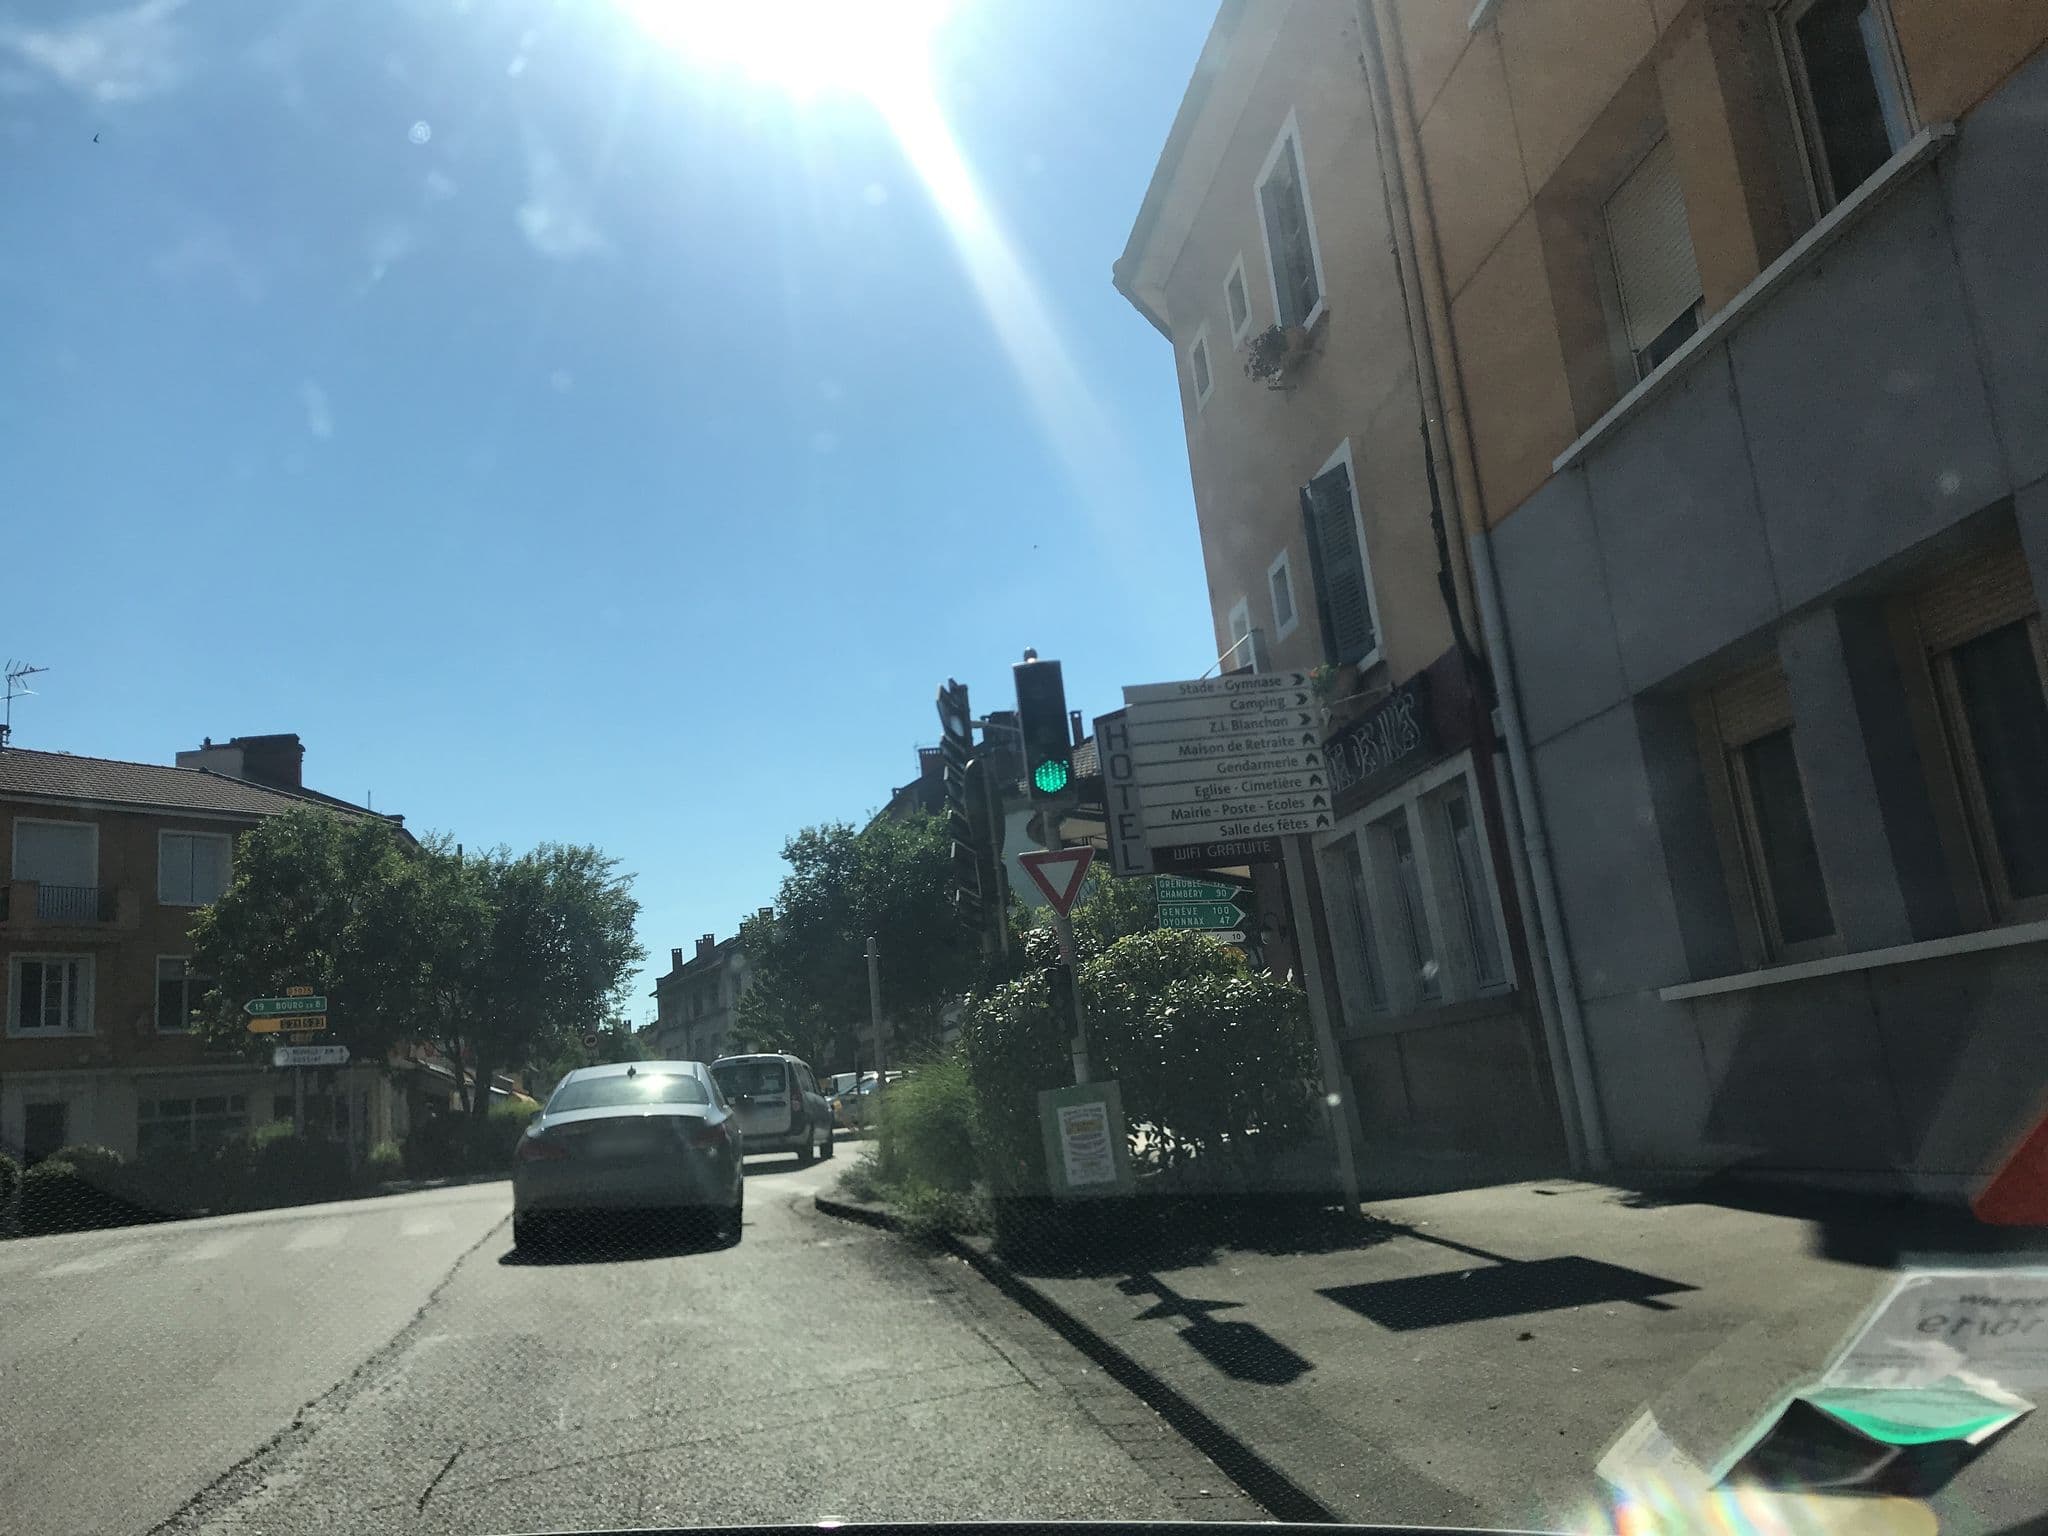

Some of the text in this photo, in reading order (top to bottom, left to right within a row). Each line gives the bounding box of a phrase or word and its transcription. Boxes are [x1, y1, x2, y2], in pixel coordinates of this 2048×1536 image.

[1178, 681, 1215, 695] Stade
[1224, 677, 1281, 692] Gymnase
[1230, 696, 1286, 711] Camping
[1231, 716, 1289, 731] Blanchon
[1179, 736, 1296, 756] Maison de Retraite
[1217, 757, 1299, 774] Gendarmerie
[1241, 778, 1302, 792] Cimetière
[1105, 723, 1144, 870] HOTEL
[1171, 806, 1211, 820] Mairie
[1222, 803, 1256, 815] Poste
[1267, 798, 1305, 811] Ecoles
[1220, 818, 1309, 837] Salle des fêtes
[1174, 840, 1271, 860] WIFI GRATUITE
[1213, 906, 1230, 914] 100
[1163, 915, 1230, 926] OYONNAX 47
[255, 1003, 264, 1011] 19
